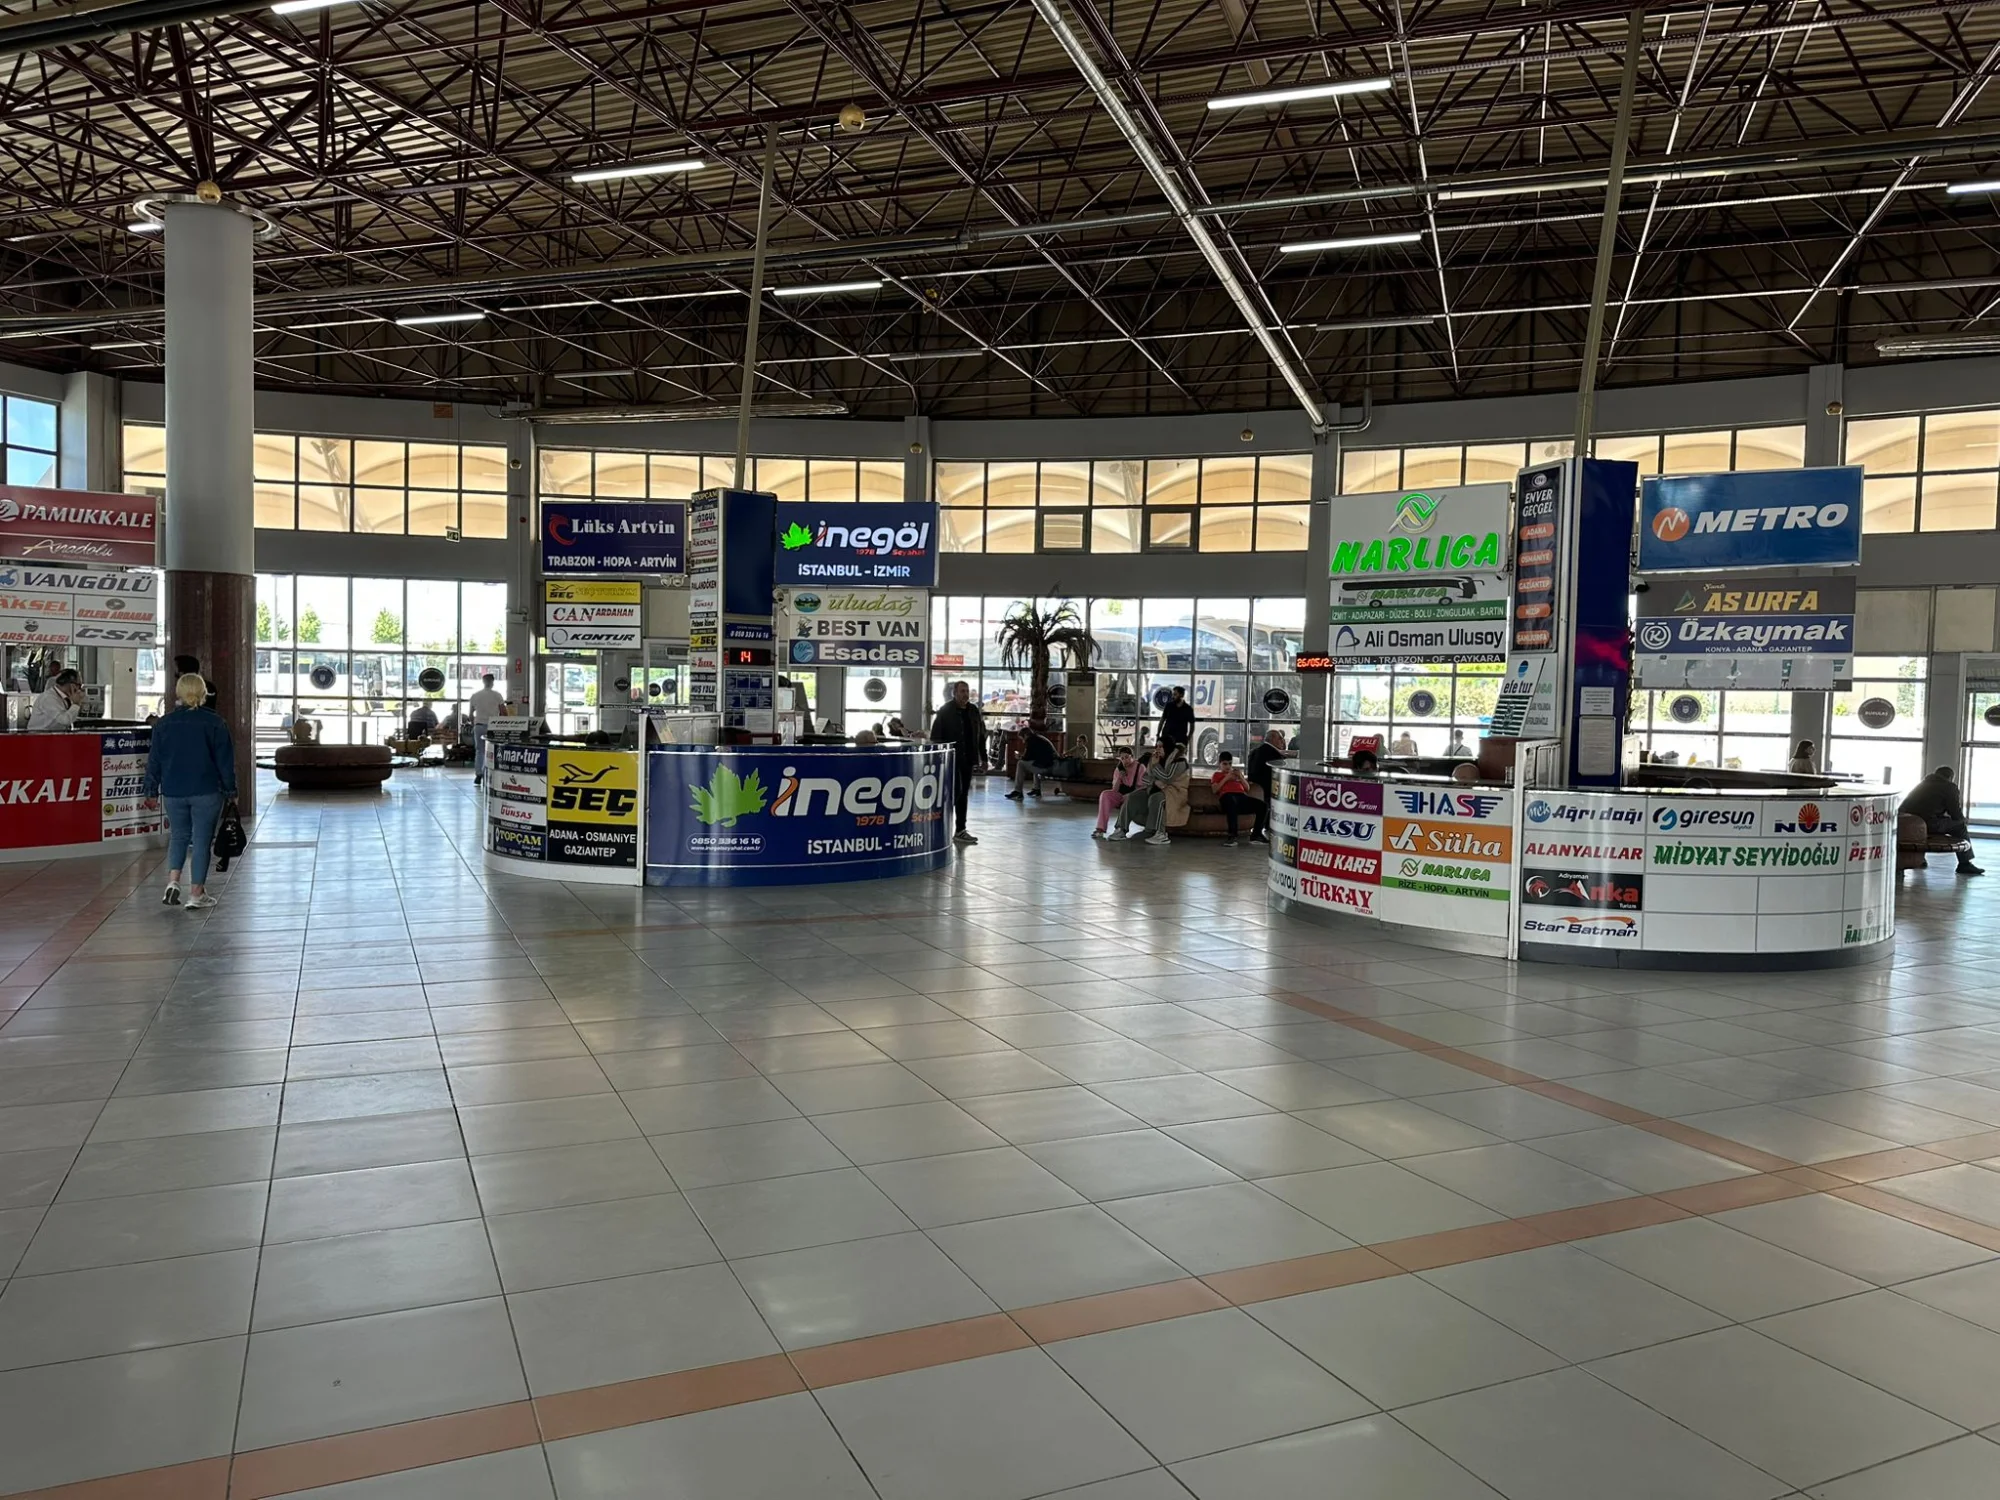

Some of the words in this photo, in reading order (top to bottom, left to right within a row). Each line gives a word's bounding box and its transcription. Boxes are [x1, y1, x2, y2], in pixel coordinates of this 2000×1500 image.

[1525, 489, 1553, 504] ENVER
[22, 504, 153, 528] PAMUKKALE
[1522, 502, 1553, 518] GEÇGEL
[1693, 503, 1849, 534] METRO
[572, 518, 614, 534] Lüks
[617, 519, 676, 535] Artvin
[815, 520, 930, 556] inegöl
[22, 539, 114, 557] Anadolu
[1330, 532, 1500, 574] NARLICA
[547, 556, 595, 567] TRABZON
[603, 556, 631, 567] HOPA
[639, 553, 677, 568] ARTVİN
[24, 572, 153, 593] VANGÖLÜ
[1370, 586, 1448, 601] NARLICA
[826, 593, 918, 617] uludağ
[1389, 608, 1410, 619] DÜZCE
[1414, 609, 1431, 618] BOLU
[1436, 607, 1475, 618] ZONGULDAK
[552, 607, 596, 622] CAN
[595, 608, 634, 617] ARDAHAN
[76, 628, 154, 641] CSR
[570, 633, 636, 641] KONTUR
[817, 620, 870, 637] BEST
[877, 621, 920, 638] VAN
[1677, 617, 1849, 646] Özkaymak
[1364, 630, 1384, 648] Ali
[1387, 630, 1444, 648] Osman
[1448, 628, 1504, 649] Ulusoy
[740, 650, 751, 663] 14
[818, 642, 920, 663] Esadaş
[1331, 655, 1371, 665] SAMSUN
[1378, 655, 1427, 664] TRABZON
[1432, 655, 1445, 663] OF
[1503, 680, 1518, 694] efe
[1519, 681, 1533, 694] tur
[771, 764, 946, 825] inegöl
[1313, 783, 1358, 810] ede
[1419, 791, 1475, 817] HAS
[855, 815, 886, 827] 1978
[1680, 808, 1755, 828] giresun
[549, 829, 579, 841] ADANA
[1302, 815, 1376, 842] AKSU
[1774, 821, 1838, 834] NUR
[1426, 829, 1503, 857] Süha
[1524, 842, 1644, 860] ALANYALILAR
[1301, 847, 1332, 868] DOĞU
[1333, 854, 1378, 875] KARS
[1652, 840, 1732, 866] MİDYAT
[1732, 841, 1840, 867] SEYYİDOĞLU
[1421, 863, 1491, 881] NARLICA
[1300, 875, 1374, 909] TÜRKAY
[1398, 879, 1417, 890] RİZE
[1424, 883, 1448, 894] HOPA
[1524, 920, 1565, 933] Star
[1567, 923, 1639, 938] Batman
